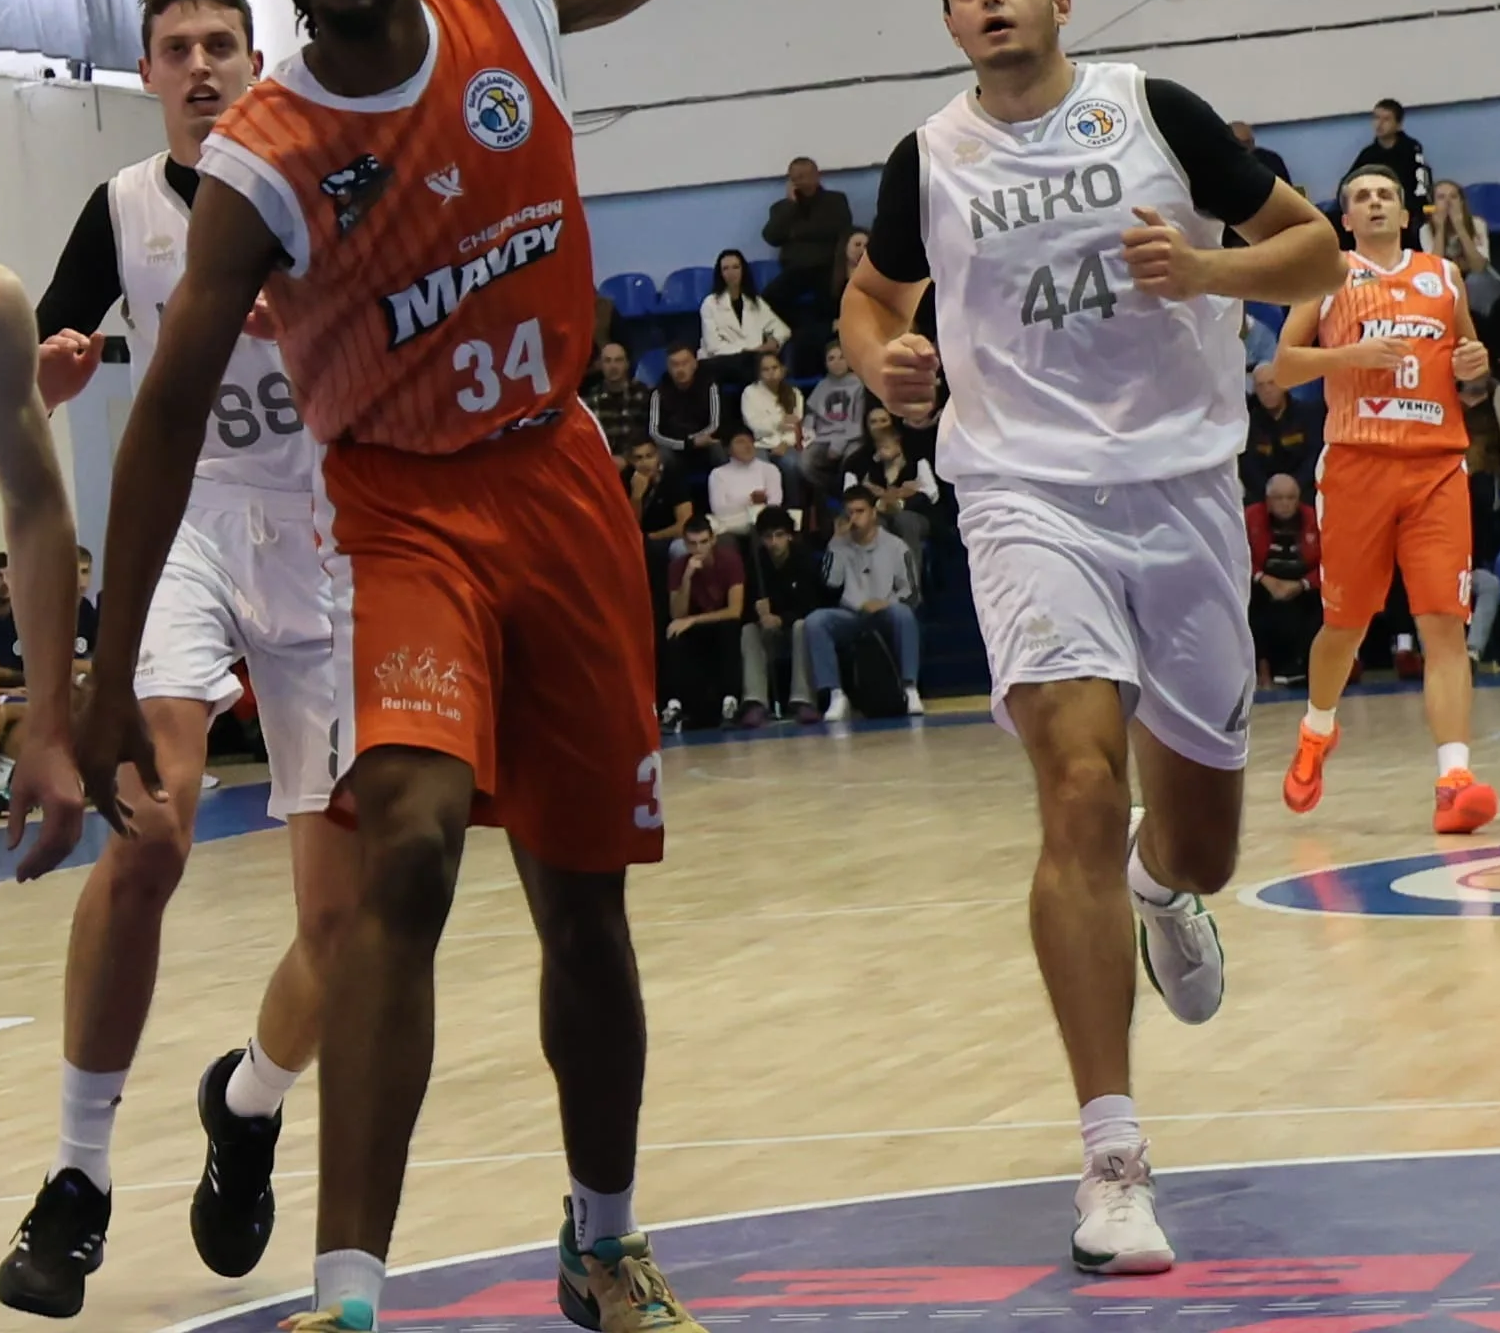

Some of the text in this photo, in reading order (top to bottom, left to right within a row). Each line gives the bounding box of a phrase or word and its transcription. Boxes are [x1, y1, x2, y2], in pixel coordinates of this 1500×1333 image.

[969, 162, 1122, 239] NIKO
[387, 219, 563, 345] MAVPY
[1019, 256, 1118, 331] 44
[453, 317, 551, 413] 34
[381, 696, 461, 721] Rehab Lab
